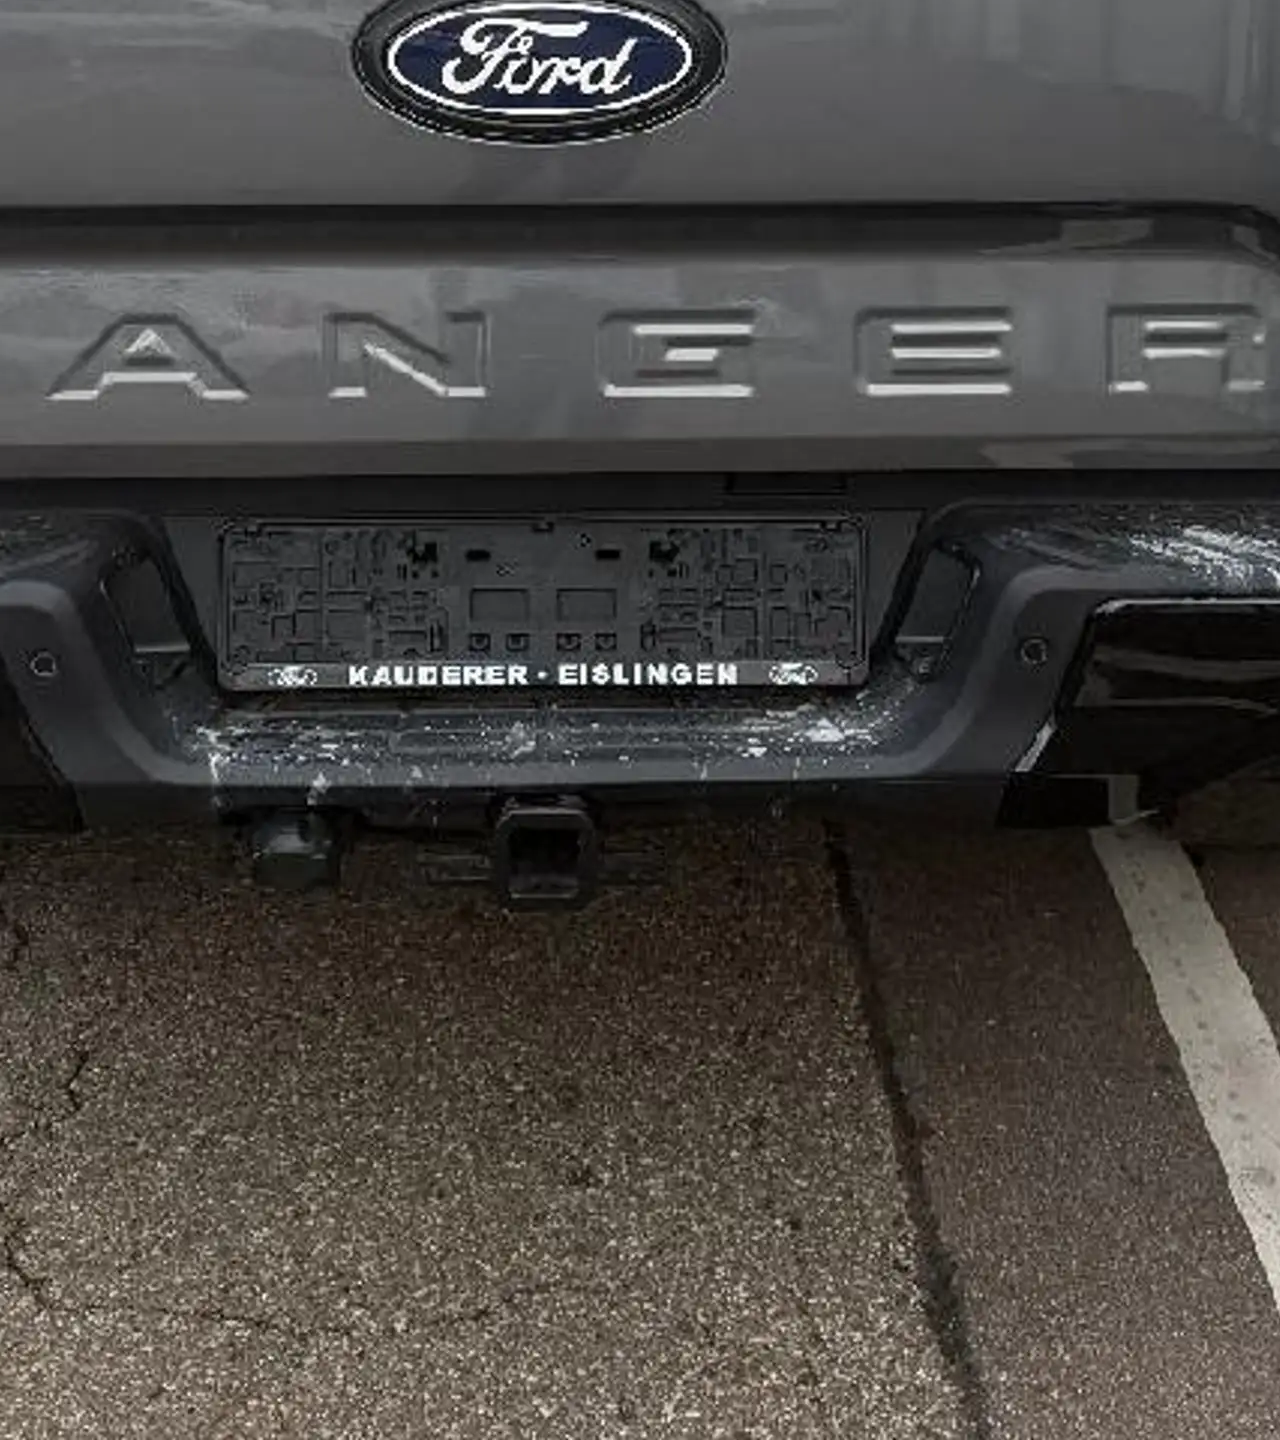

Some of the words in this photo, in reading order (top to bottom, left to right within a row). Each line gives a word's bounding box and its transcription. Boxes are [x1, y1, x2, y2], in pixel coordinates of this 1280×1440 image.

[441, 16, 639, 95] Ford
[348, 665, 529, 686] KAUDERER
[558, 663, 738, 685] EISLINGEN
